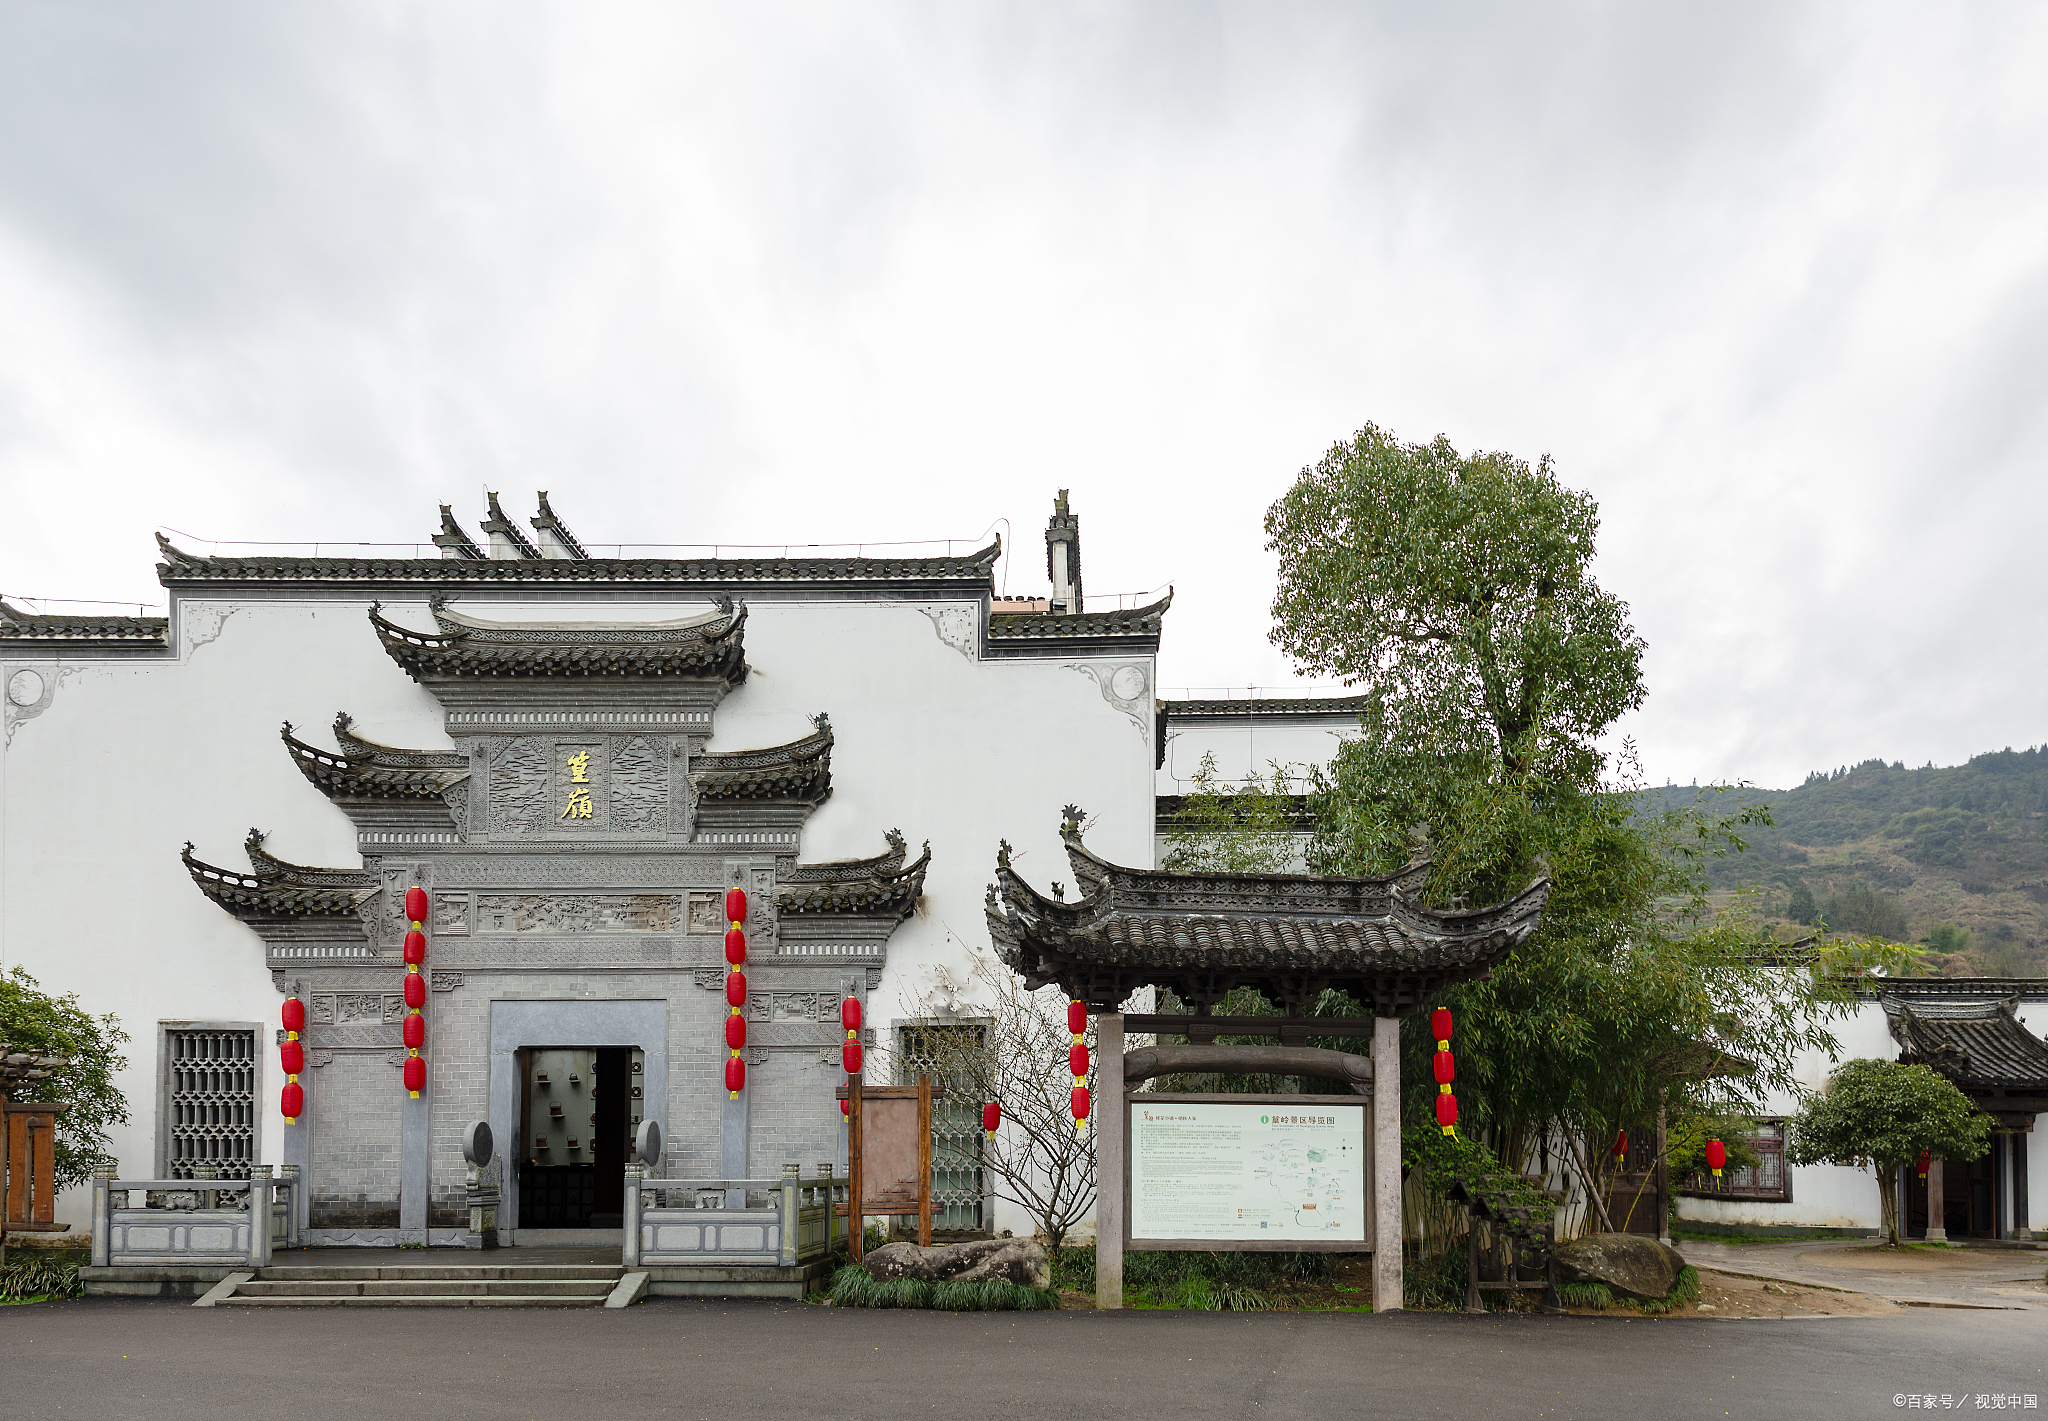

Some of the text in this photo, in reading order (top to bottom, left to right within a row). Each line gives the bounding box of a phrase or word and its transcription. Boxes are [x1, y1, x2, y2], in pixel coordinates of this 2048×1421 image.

[1271, 1115, 1335, 1125] 篁岭景区导览图
